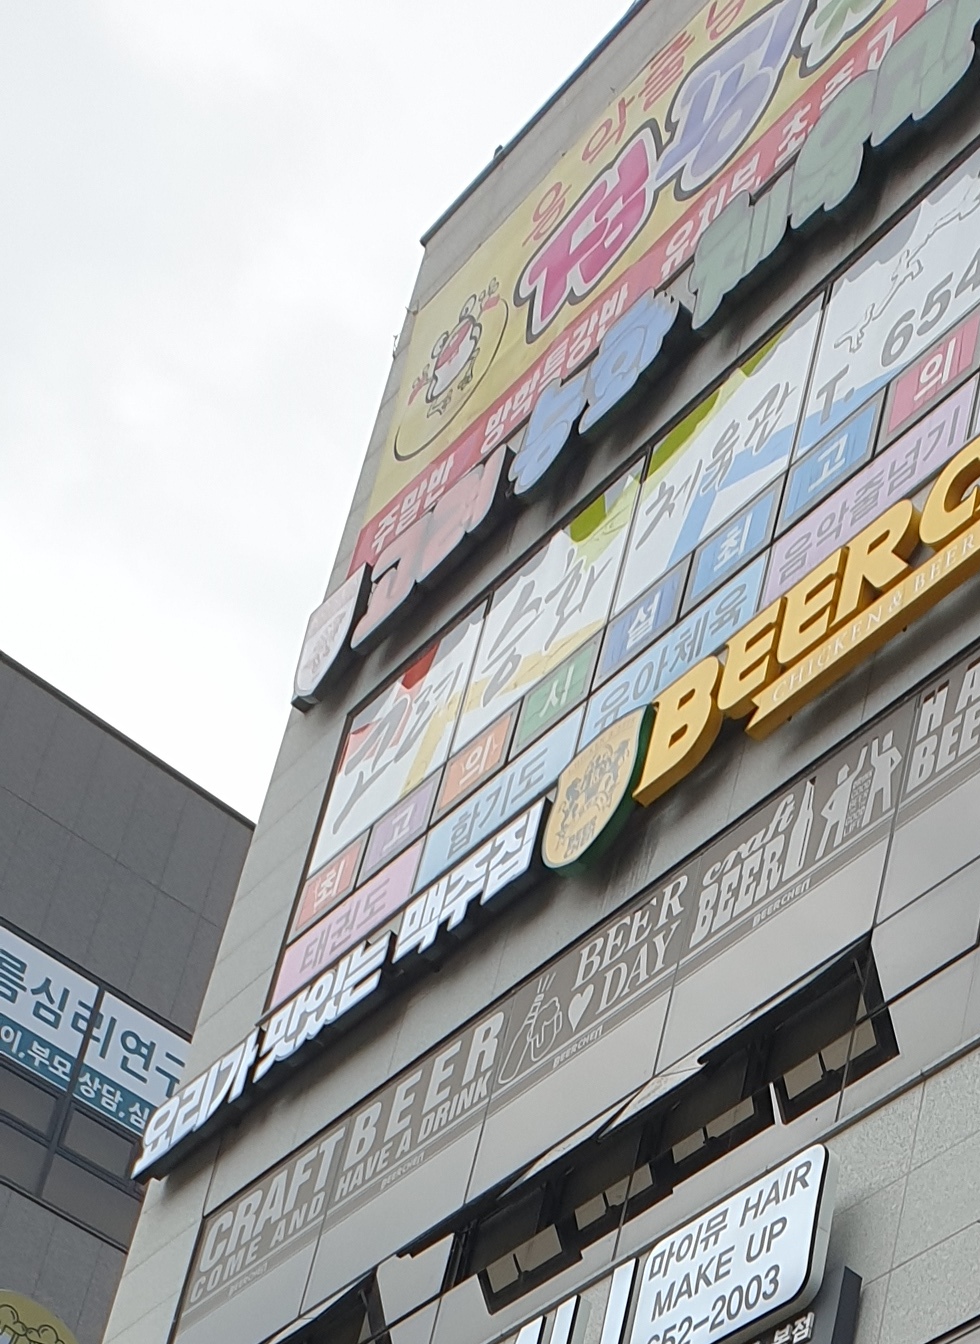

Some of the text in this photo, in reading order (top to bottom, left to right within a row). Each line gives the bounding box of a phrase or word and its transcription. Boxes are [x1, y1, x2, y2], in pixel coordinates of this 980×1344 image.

[815, 364, 855, 425] T.
[350, 443, 508, 649] 고려
[508, 287, 680, 495] 승화
[371, 455, 456, 552] 주말반
[771, 607, 883, 704] CHICKEN
[913, 535, 976, 593] BEER
[299, 877, 390, 974] 태권도
[447, 748, 549, 860] 합기도
[594, 578, 747, 729] 유아체육
[778, 406, 960, 586] 음악줄넘기
[332, 662, 465, 835] 고려
[483, 545, 613, 708] 승화
[691, 838, 783, 945] BEER
[703, 795, 795, 883] craft
[132, 797, 547, 1179] 요리가 맛있는 맥주집
[571, 875, 689, 998] BEER
[595, 930, 681, 1027] DAY
[189, 1235, 262, 1303] COME
[269, 1190, 326, 1249] AND
[334, 1138, 394, 1203] HAVE
[394, 1127, 413, 1160] A
[417, 1074, 493, 1145] DRINK
[199, 1011, 505, 1273] CRAFT BEER
[647, 1158, 811, 1283] 마이뮤 HAIR
[651, 1216, 789, 1323] MAKE UP
